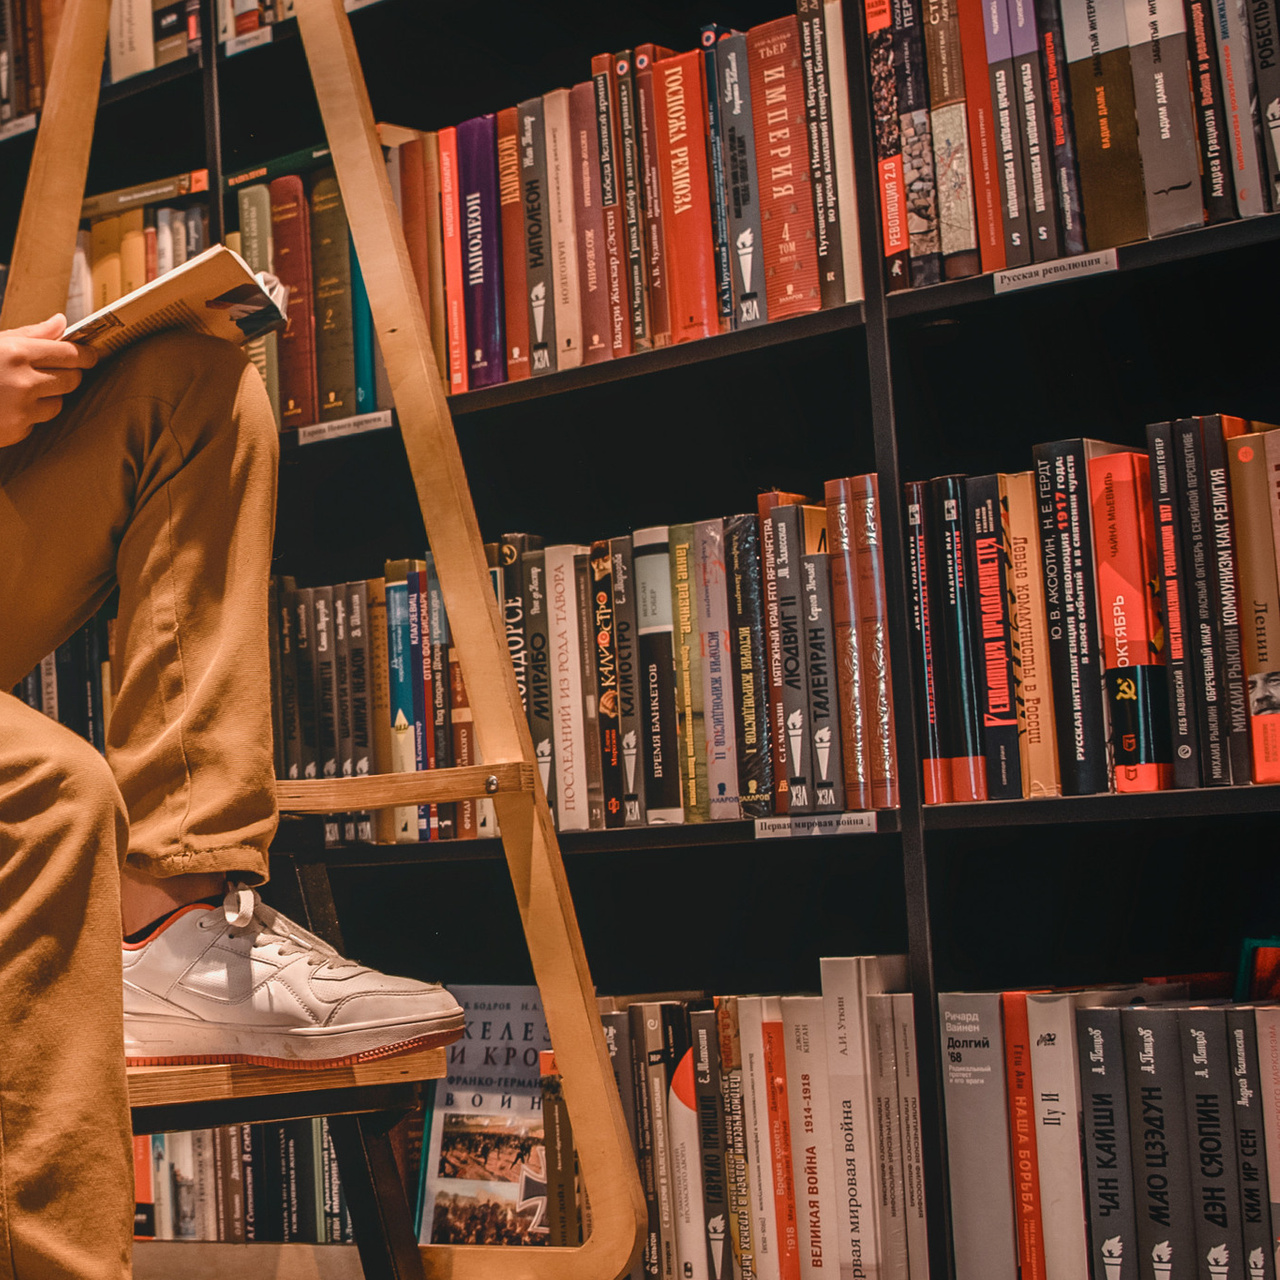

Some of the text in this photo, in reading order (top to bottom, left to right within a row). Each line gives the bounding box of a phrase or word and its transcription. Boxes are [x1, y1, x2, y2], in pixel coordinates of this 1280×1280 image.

[1148, 20, 1162, 63] ЗАБЫТЫЙ
[595, 76, 607, 112] армии
[1154, 72, 1167, 104] ДАМЬЕ
[1224, 45, 1239, 112] ФРАНЦУЗСКОЙ
[1233, 114, 1245, 171] РЕВОЛЮЦИИ
[597, 115, 610, 162] Великой
[664, 66, 692, 214] ГОСПОЖА РЕМЮЗА
[1158, 106, 1170, 139] ВАДИМ
[498, 134, 520, 206] НАПОЛЕОН
[600, 164, 613, 205] Победа
[466, 192, 485, 285] НАПОЛЕОН
[525, 180, 544, 268] НАПОЛЕОН
[884, 162, 901, 247] РЕВОЛЮЦИЯ 2.0
[558, 241, 569, 305] НАПОЛЕОН
[607, 257, 620, 304] Жискар
[1000, 257, 1100, 284] Русская революция
[611, 306, 623, 349] Валери
[1104, 473, 1119, 557] ЧАЙНА МЬЕВИЛЬ
[408, 594, 419, 645] КЛАУЗЕВИЦ
[1112, 595, 1129, 668] ОКТЯБРЬ
[1210, 468, 1247, 732] МИХАИЛ РЫКЛИН КОММУНИЗМ КАК РЕЛИГИЯ
[1253, 601, 1268, 662] Ленин
[419, 592, 432, 681] ОТТО ФОН БИСМАРК
[530, 632, 548, 720] МИРАБО
[809, 628, 830, 722] ТАЛЕЙРАН
[760, 817, 864, 831] Первая мировая война
[450, 1045, 466, 1063] И
[948, 1036, 989, 1048] Долгий
[700, 1095, 720, 1204] ГАВРИЛО ПРИНЦИП
[805, 1146, 820, 1195] ВОЙНА
[1092, 1093, 1119, 1217] ЧАН КАЙШИ
[1142, 1087, 1171, 1227] МАО ЦЗЭДУН
[1196, 1095, 1227, 1228] ДЭН СЯОПИН
[809, 1200, 822, 1268] ВЕЛИКАЯ
